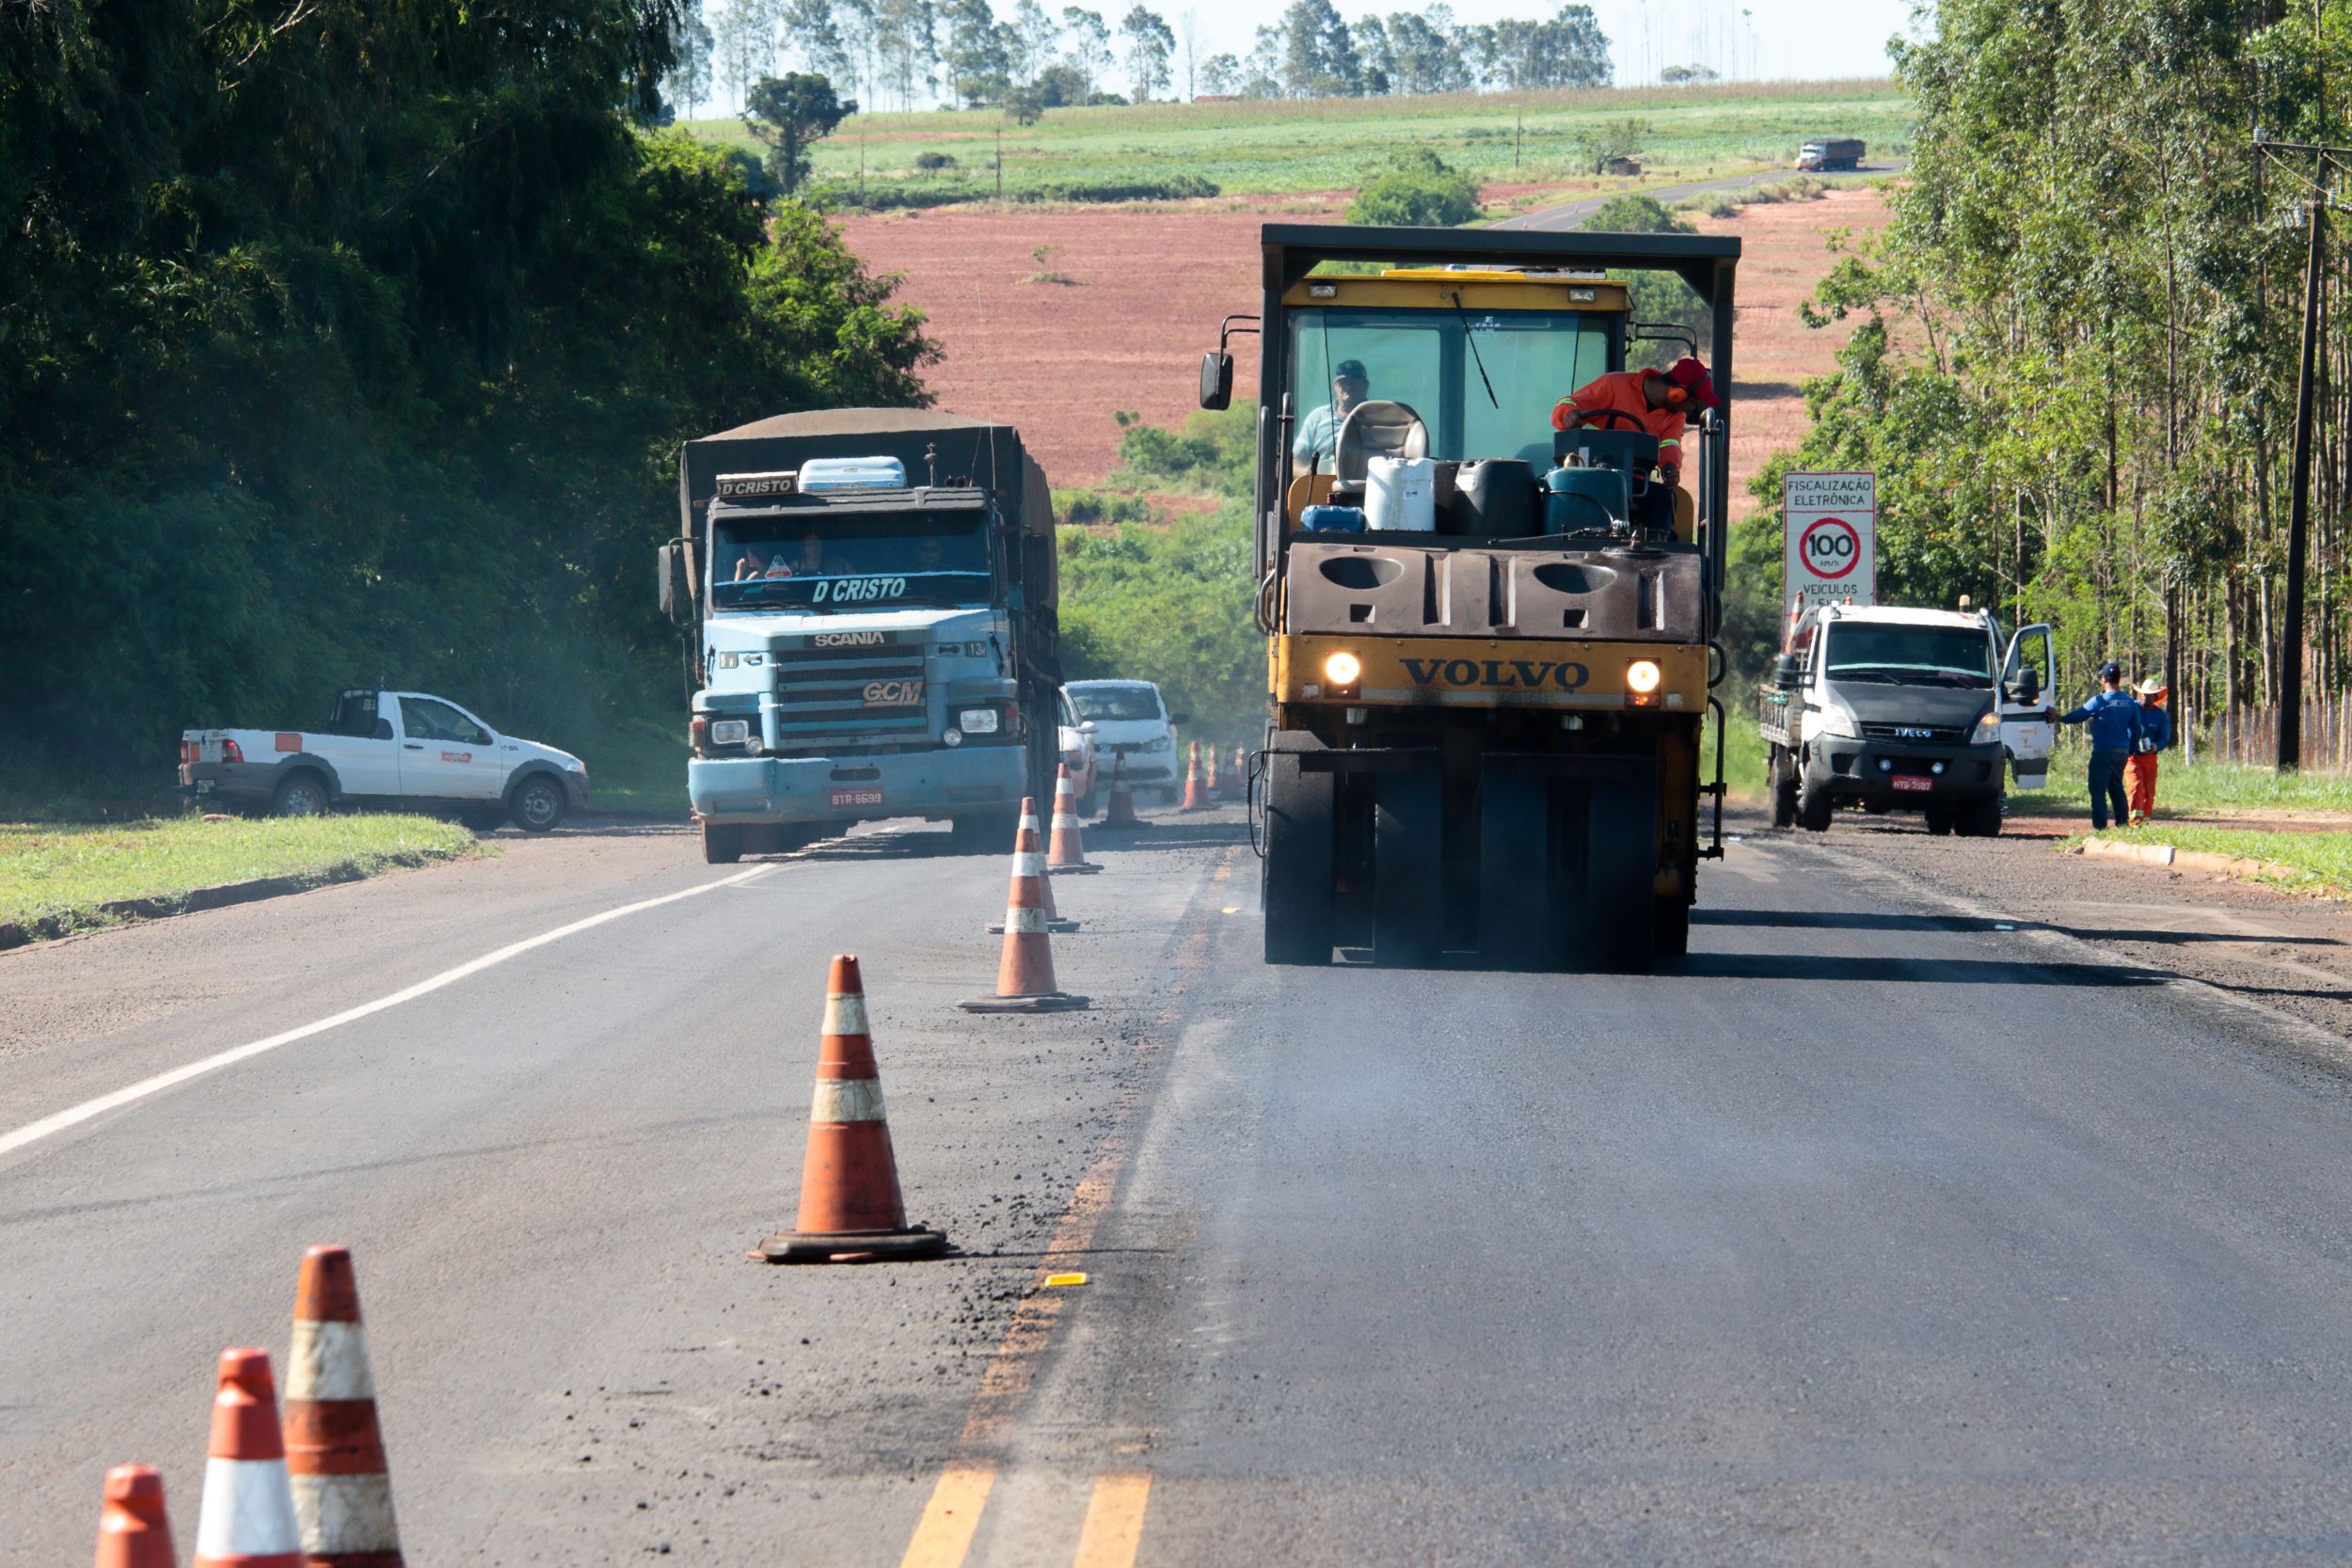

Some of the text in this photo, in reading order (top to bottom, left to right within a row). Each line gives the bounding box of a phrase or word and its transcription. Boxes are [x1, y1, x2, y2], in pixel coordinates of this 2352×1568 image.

[1788, 478, 1871, 492] FISCALIZAÇÃO
[1794, 492, 1865, 506] ELETRÔNICA
[1808, 533, 1853, 557] 100
[812, 577, 906, 602] D CRISTO
[1803, 578, 1858, 594] VEÍCULOS
[814, 631, 884, 647] SCANIA
[1399, 657, 1590, 689] VOLVO
[863, 680, 923, 705] GCM
[1895, 727, 1931, 738] IVECO
